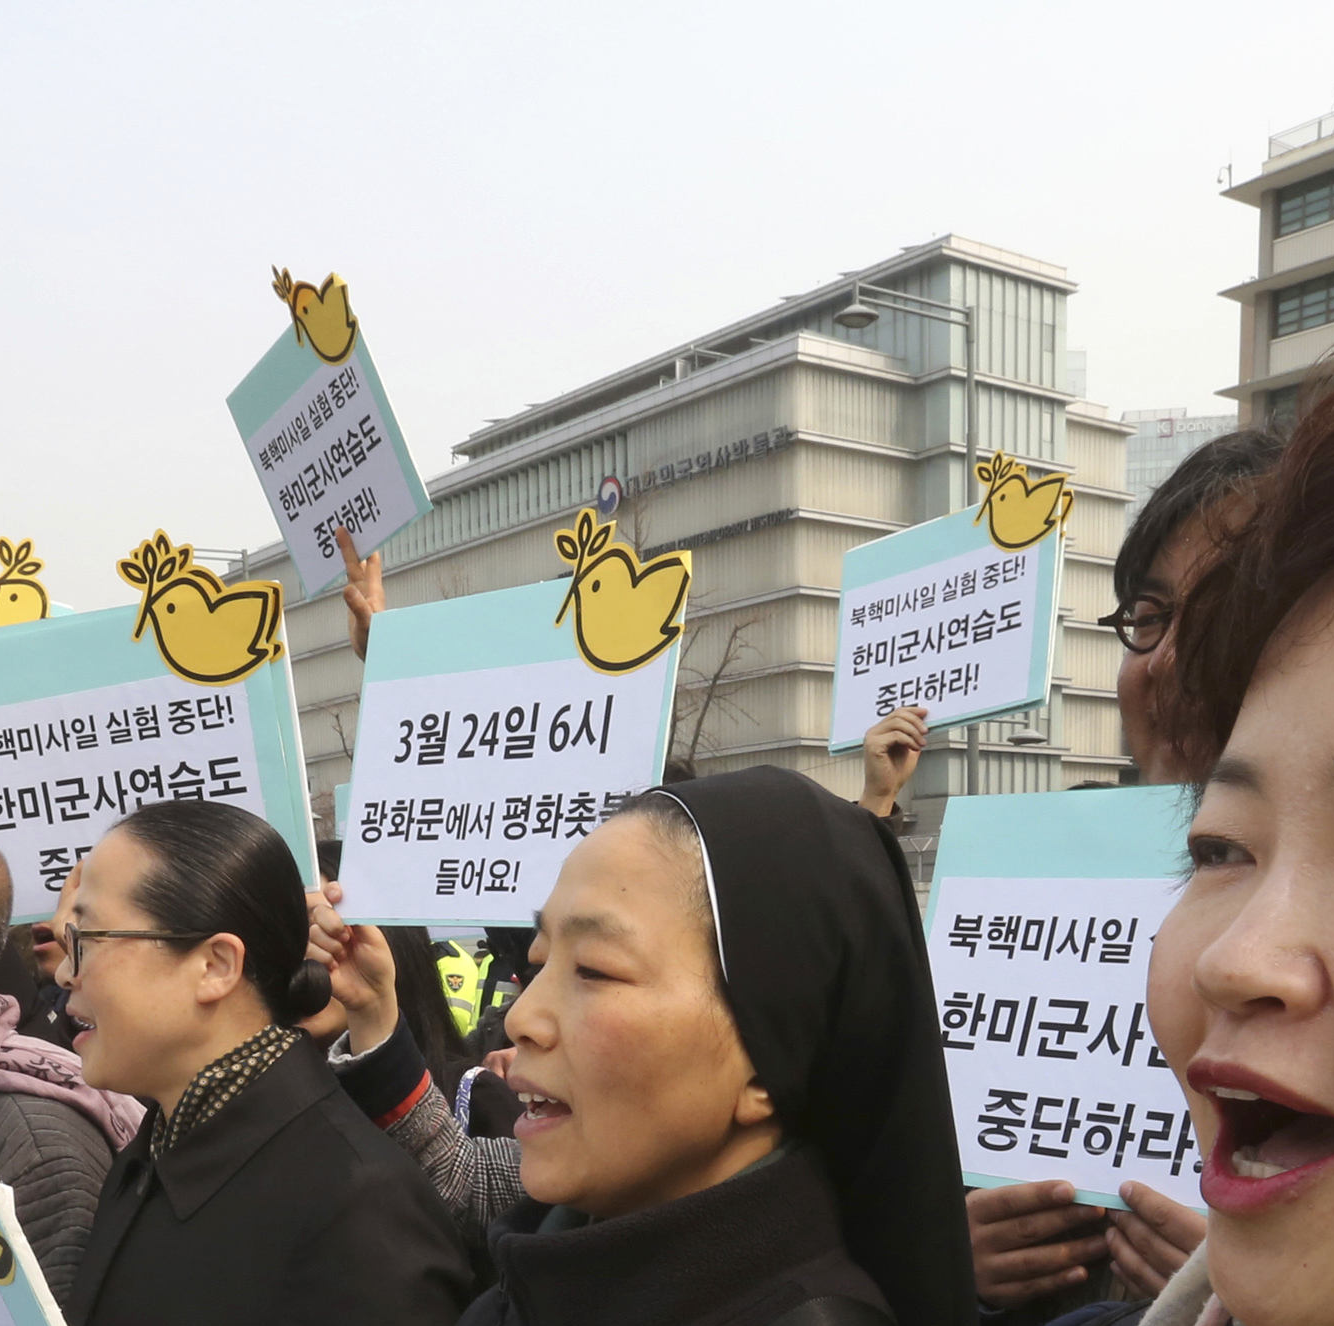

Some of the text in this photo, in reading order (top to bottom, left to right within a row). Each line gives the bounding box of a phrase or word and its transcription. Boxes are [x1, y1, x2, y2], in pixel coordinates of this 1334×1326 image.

[258, 366, 361, 472] 북핵미사일 실험 중단!
[1176, 420, 1211, 433] bank
[278, 414, 382, 523] 한미군사연습도
[850, 554, 1027, 628] 북핵미사일 실험 중단!
[852, 599, 1022, 677] 한미군사연습도
[875, 662, 980, 718] 중단하라!
[105, 704, 162, 745] 실험
[167, 694, 236, 735] 중단!
[393, 694, 615, 766] 3월 24일 6시
[360, 798, 496, 844] 광화문에서
[435, 857, 521, 896] 들어요!
[947, 913, 1139, 965] 북핵미사일
